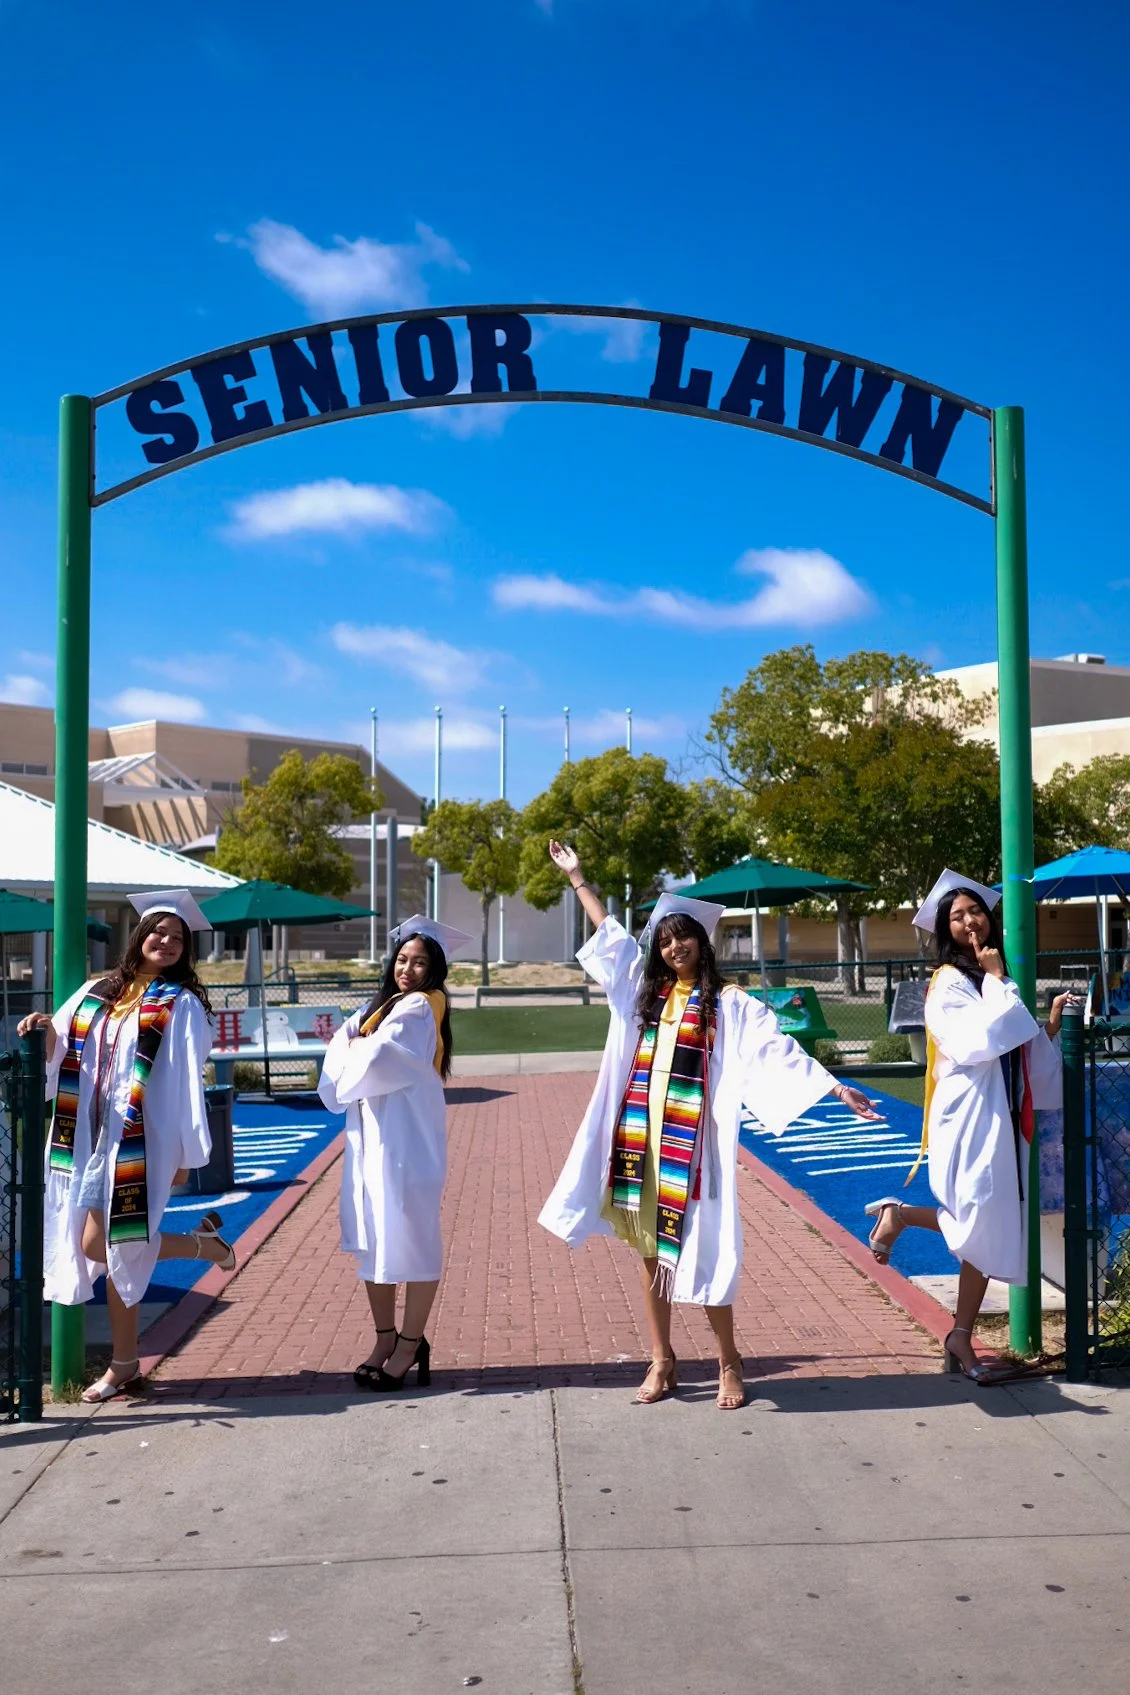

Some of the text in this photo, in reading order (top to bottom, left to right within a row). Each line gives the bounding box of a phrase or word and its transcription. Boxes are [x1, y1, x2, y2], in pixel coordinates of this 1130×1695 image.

[126, 312, 964, 479] SENIOR LAWN
[620, 1152, 640, 1162] CLASS
[118, 1188, 140, 1196] CLASS
[662, 1209, 679, 1220] CLASS
